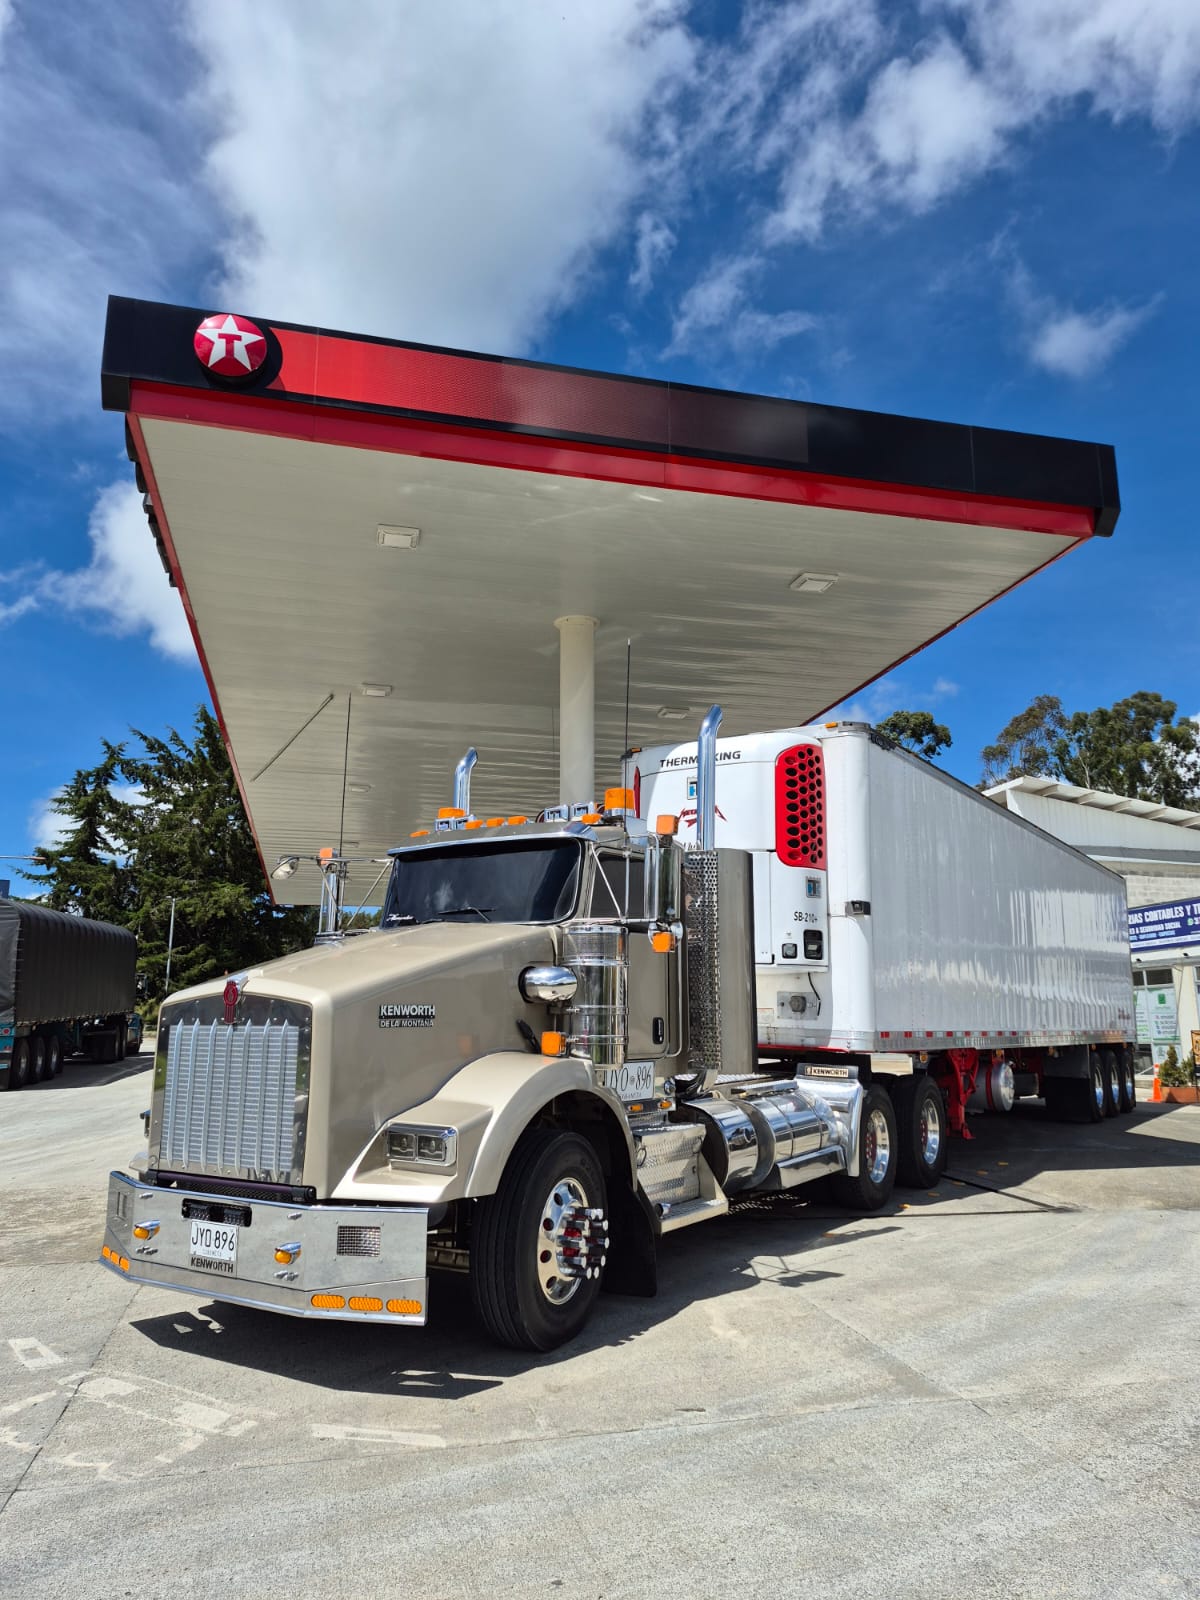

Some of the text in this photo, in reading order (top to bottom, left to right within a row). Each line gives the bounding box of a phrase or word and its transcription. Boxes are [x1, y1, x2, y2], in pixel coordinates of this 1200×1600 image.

[218, 333, 242, 358] T
[660, 755, 698, 768] THERM
[1144, 906, 1185, 922] CONTABLES
[1185, 904, 1192, 916] Y
[380, 1004, 436, 1016] KENWORTH
[380, 1020, 390, 1028] DE
[635, 1065, 652, 1090] 896
[813, 1068, 848, 1077] KENWORTH
[214, 1230, 235, 1251] 896
[190, 1257, 234, 1273] KENWORTH
